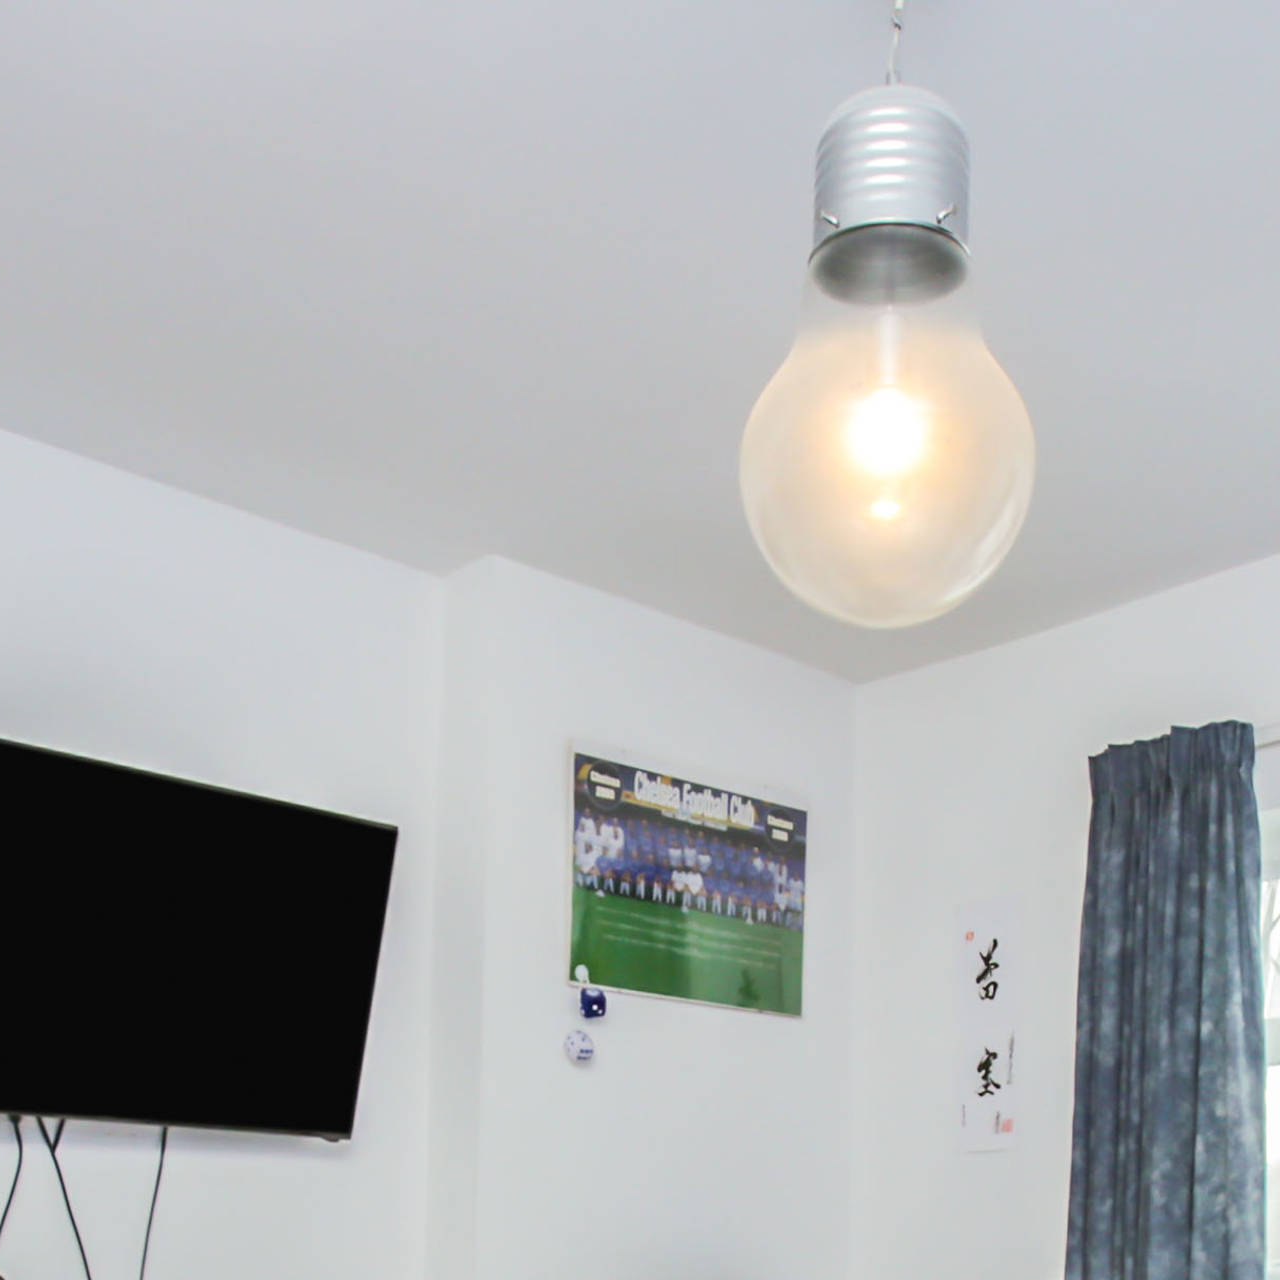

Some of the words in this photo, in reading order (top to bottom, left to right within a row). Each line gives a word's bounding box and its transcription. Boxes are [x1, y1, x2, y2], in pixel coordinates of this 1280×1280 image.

[634, 770, 681, 809] Chelsea
[682, 783, 729, 821] Football
[730, 794, 755, 827] Club
